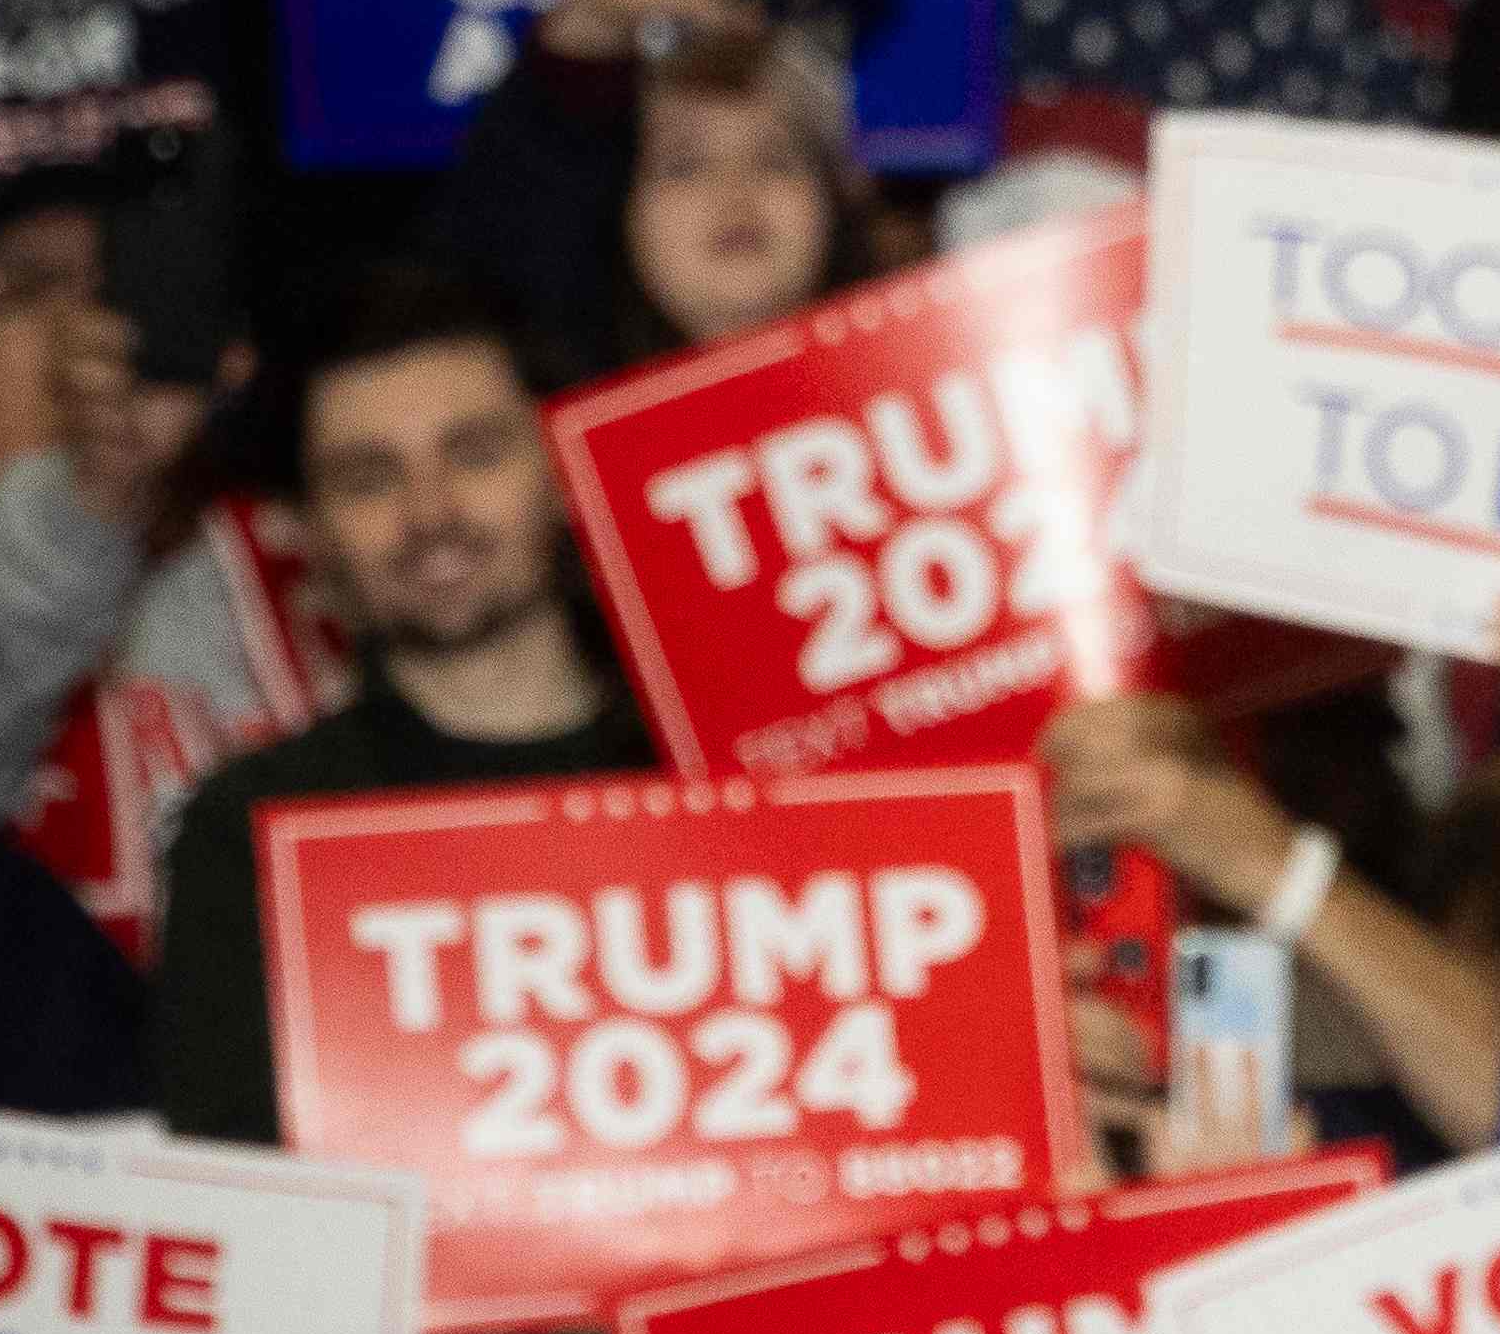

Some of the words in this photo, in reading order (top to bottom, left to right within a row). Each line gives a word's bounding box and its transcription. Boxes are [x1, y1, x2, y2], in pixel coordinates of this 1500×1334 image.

[643, 325, 1142, 593] TRUM
[1298, 379, 1469, 515] TO
[775, 492, 1105, 695] 202
[350, 861, 985, 1034] TRUMP
[458, 999, 916, 1159] 2024
